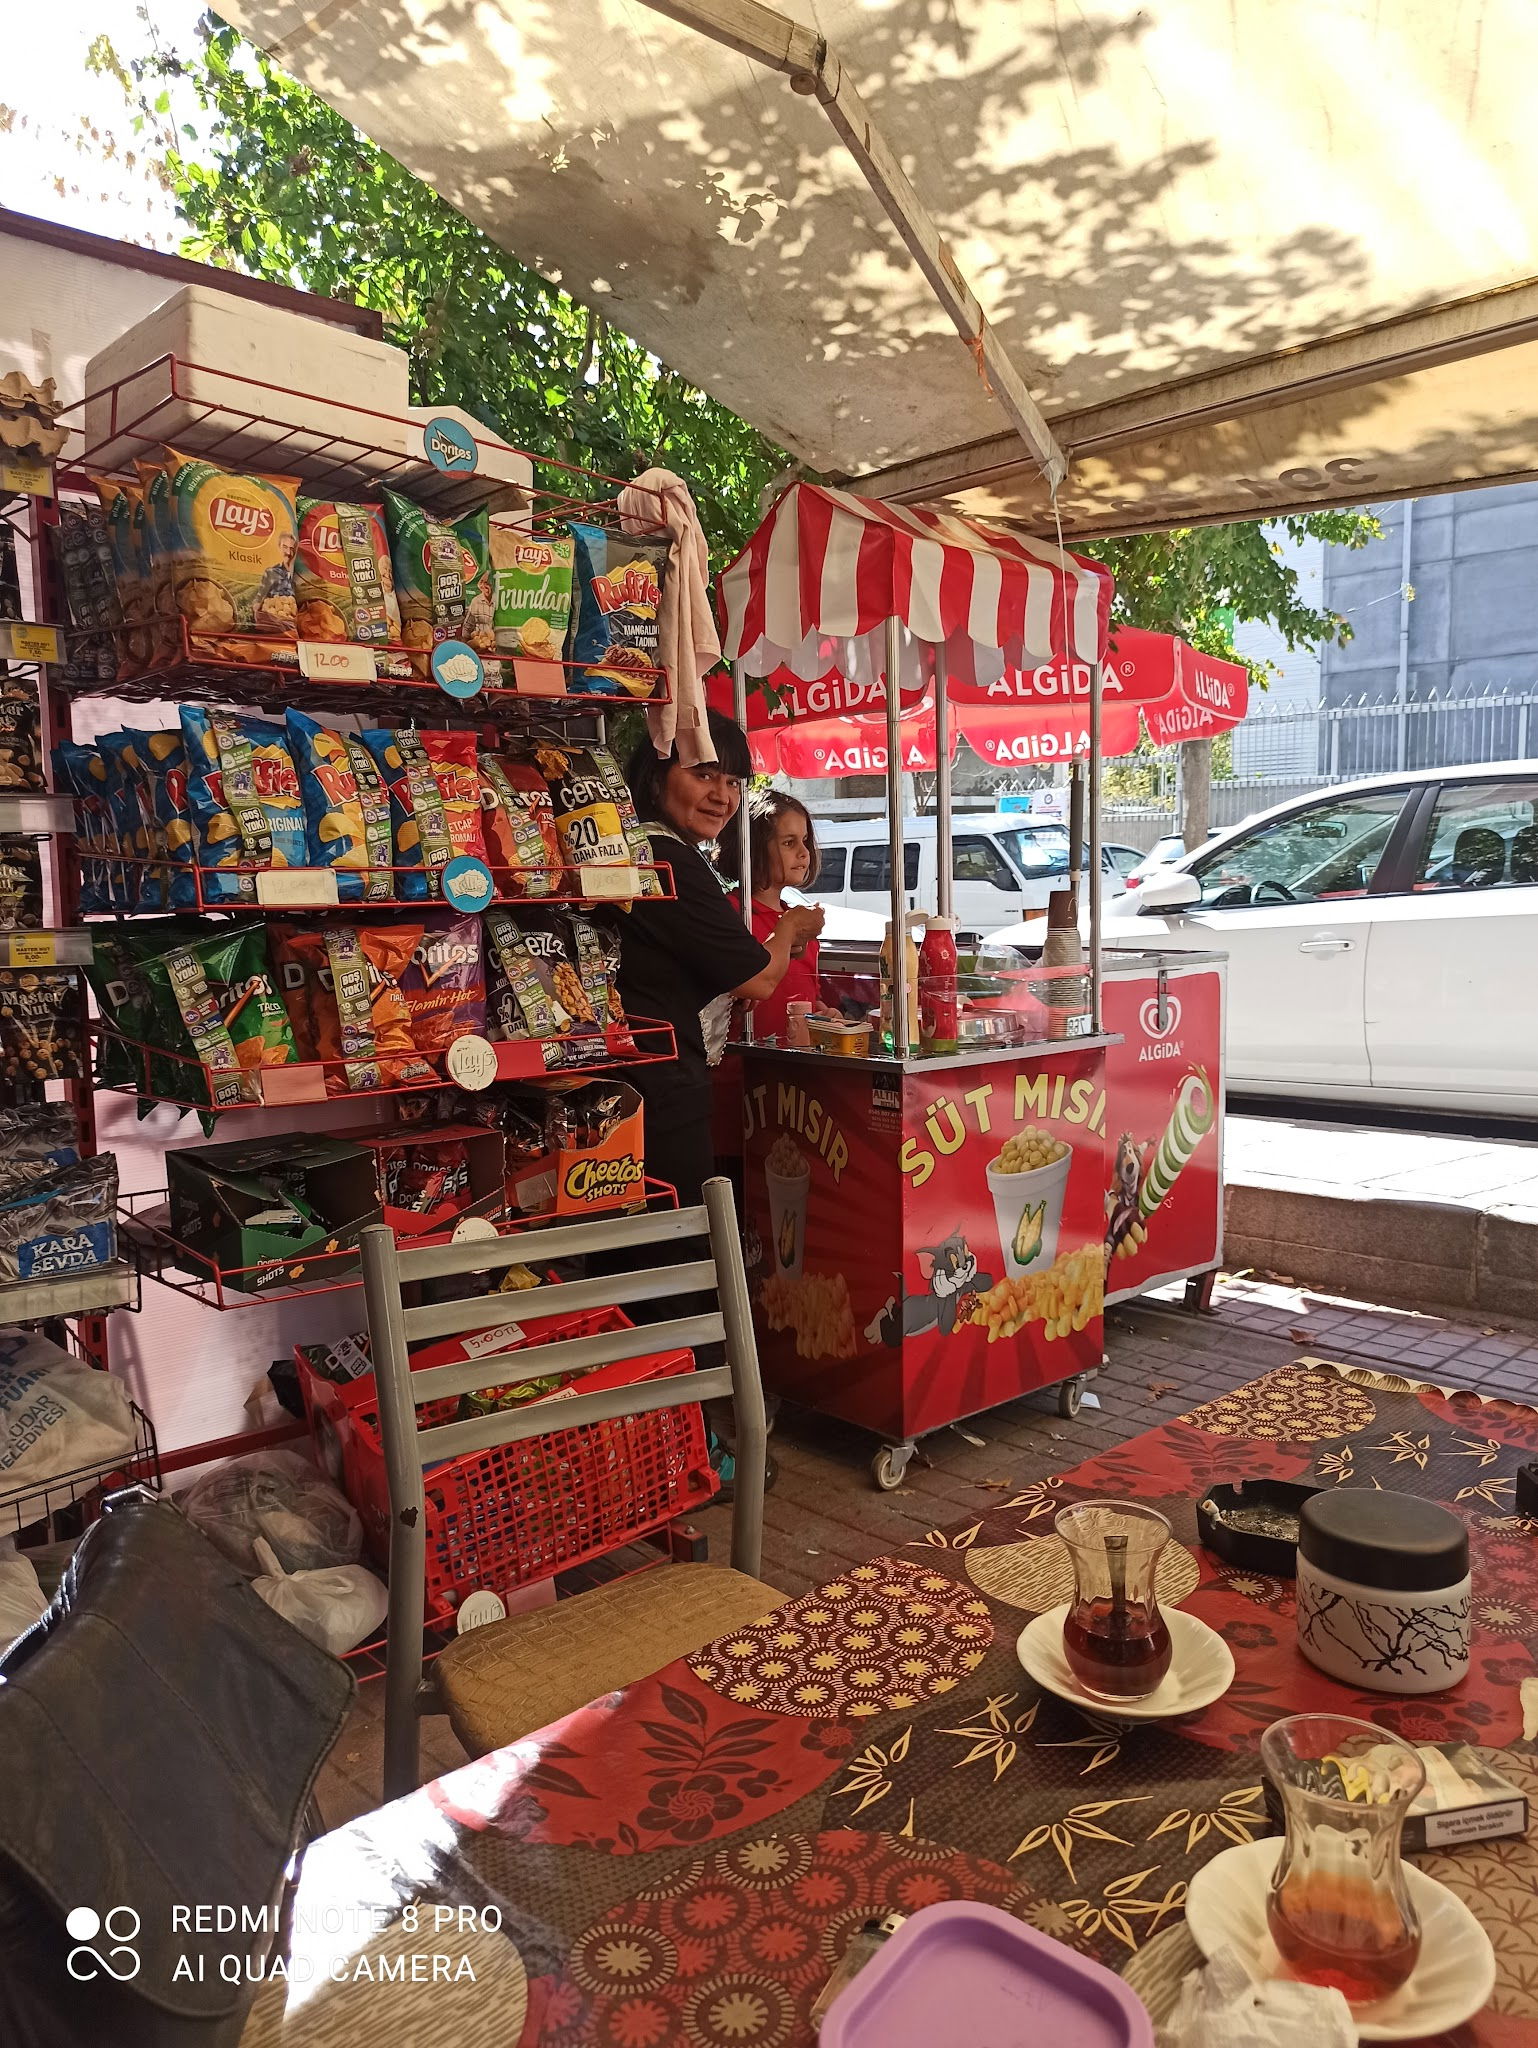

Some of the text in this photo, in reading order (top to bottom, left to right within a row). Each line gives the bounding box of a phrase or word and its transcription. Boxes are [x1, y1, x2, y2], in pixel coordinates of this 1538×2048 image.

[431, 438, 472, 461] Doritos
[228, 550, 263, 565] Klasik
[572, 848, 597, 864] DAHA
[599, 843, 624, 859] FAZLA
[341, 971, 361, 985] BOŞ
[342, 982, 364, 998] YOK!
[450, 989, 474, 1003] Hot
[20, 1002, 50, 1016] Nut
[257, 1002, 281, 1013] TACO
[777, 1082, 849, 1184] MISIR
[898, 1083, 994, 1188] SÜT
[566, 1155, 645, 1198] Cheetos
[586, 1184, 627, 1202] SHOTS
[31, 1234, 94, 1260] KARA
[31, 1250, 98, 1274] SEVDA
[257, 1266, 285, 1287] SHOTS
